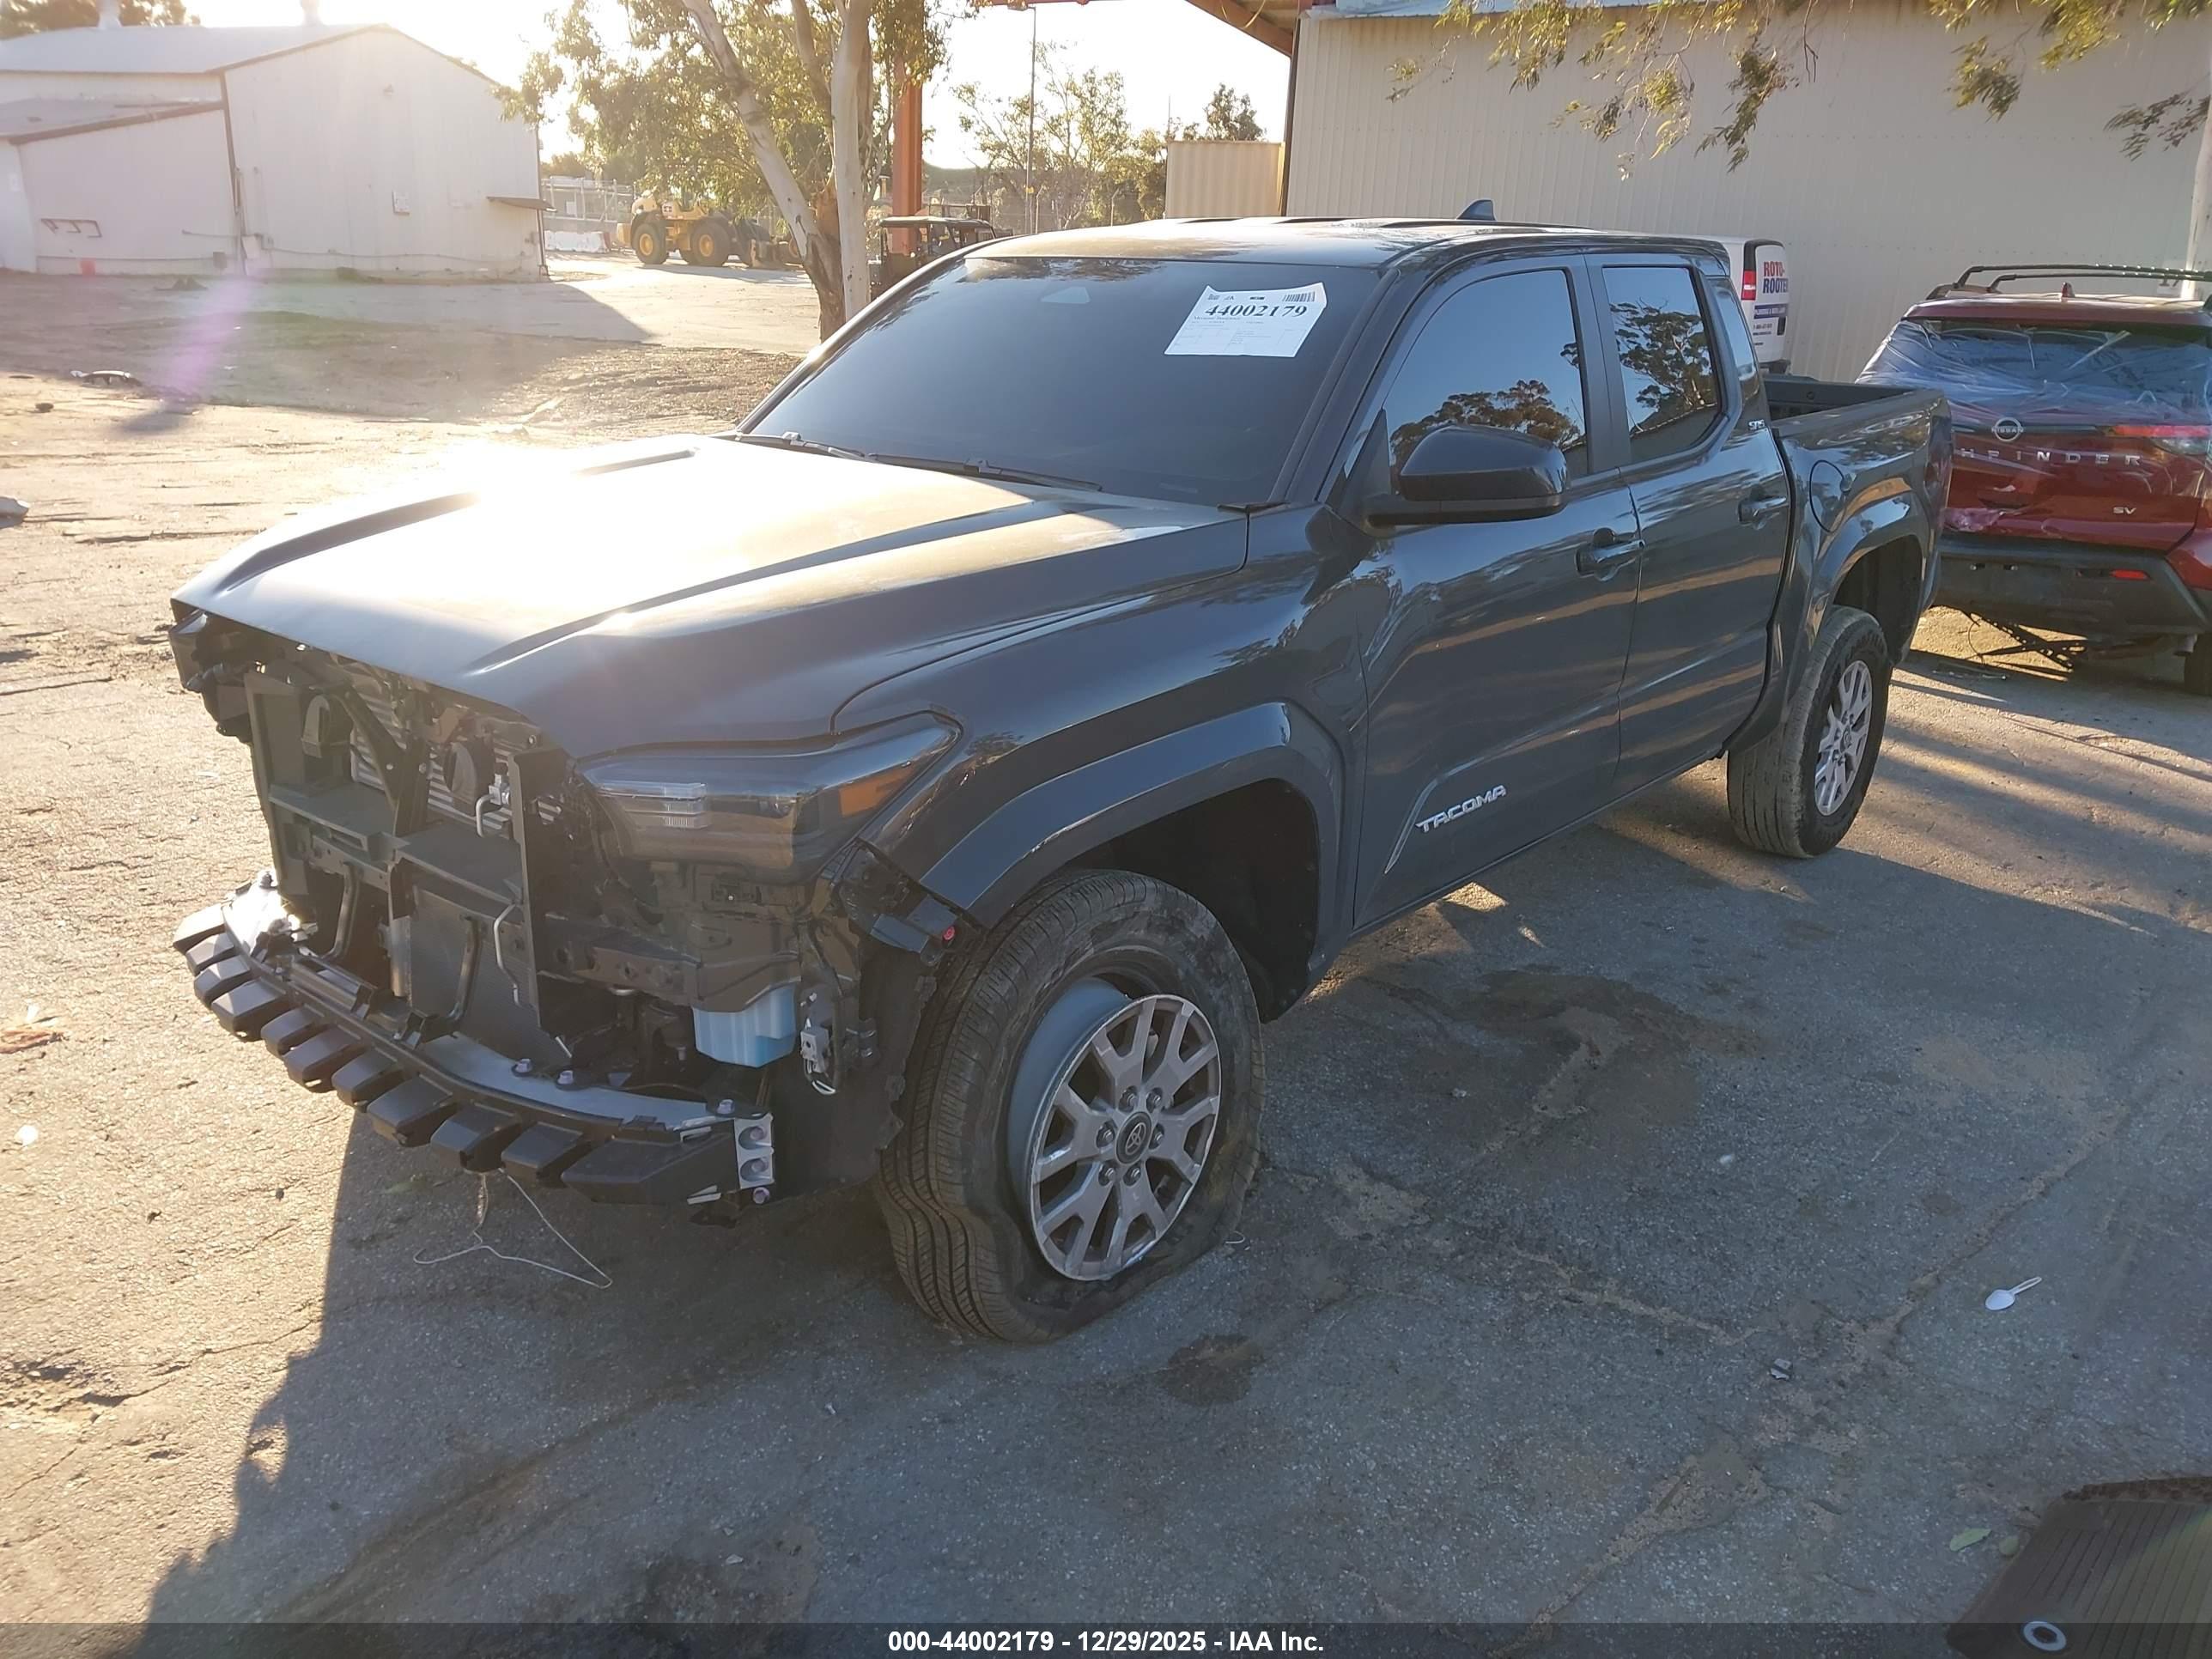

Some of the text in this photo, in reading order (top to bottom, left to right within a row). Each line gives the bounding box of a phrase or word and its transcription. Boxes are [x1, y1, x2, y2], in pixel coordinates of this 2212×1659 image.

[1763, 261, 1785, 276] ROTO-
[1204, 304, 1308, 318] 44002179
[1415, 784, 1507, 833] TACOMA
